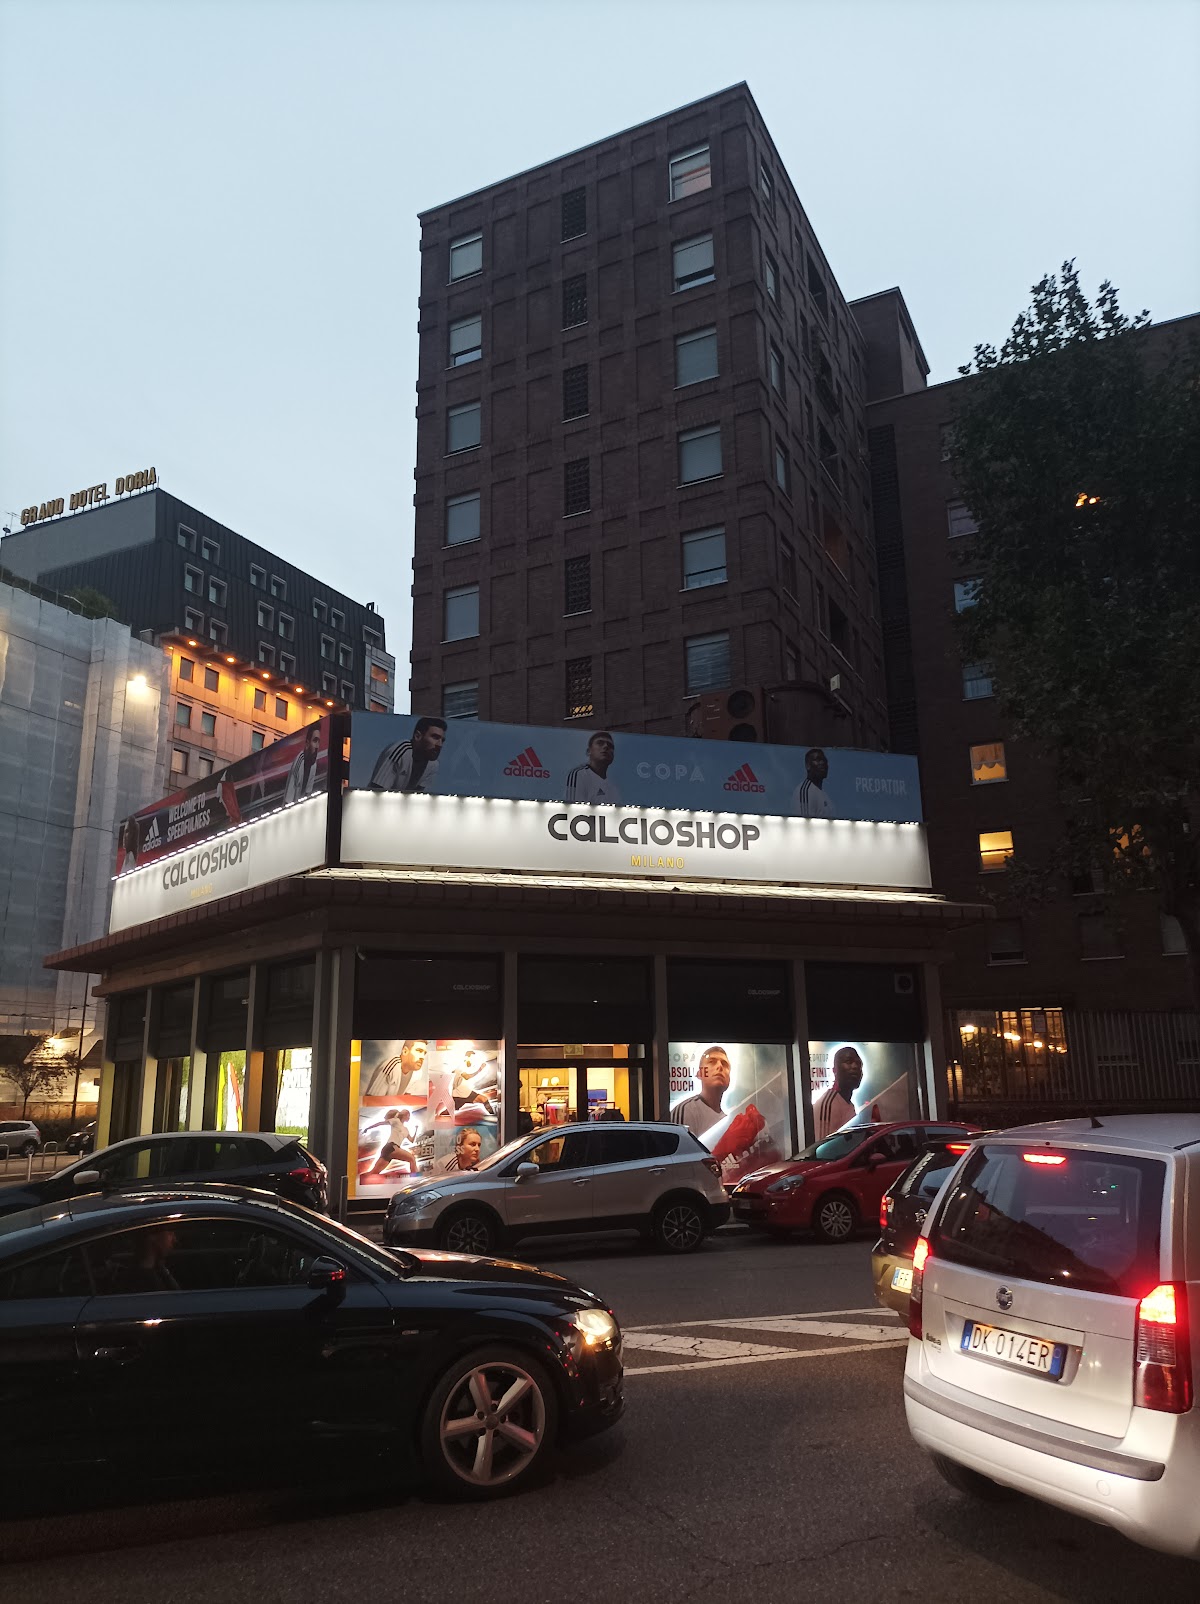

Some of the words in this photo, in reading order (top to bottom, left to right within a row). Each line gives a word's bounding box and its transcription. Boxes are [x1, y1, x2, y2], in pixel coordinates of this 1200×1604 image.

[20, 497, 64, 526] GRAND
[69, 482, 110, 511] HOTEL
[115, 466, 157, 496] DORIA
[503, 766, 551, 779] adidas
[637, 761, 705, 782] COPA
[723, 781, 766, 793] adidas
[855, 777, 907, 796] PREDATOR
[168, 796, 197, 823] WELCOME
[197, 792, 206, 810] TO
[167, 808, 211, 843] SPEEDFULNESS
[142, 836, 162, 853] adidas
[630, 855, 685, 869] MILANO
[669, 1080, 694, 1092] OUCH
[972, 1326, 992, 1352] DK
[995, 1333, 1050, 1369] 014ER
